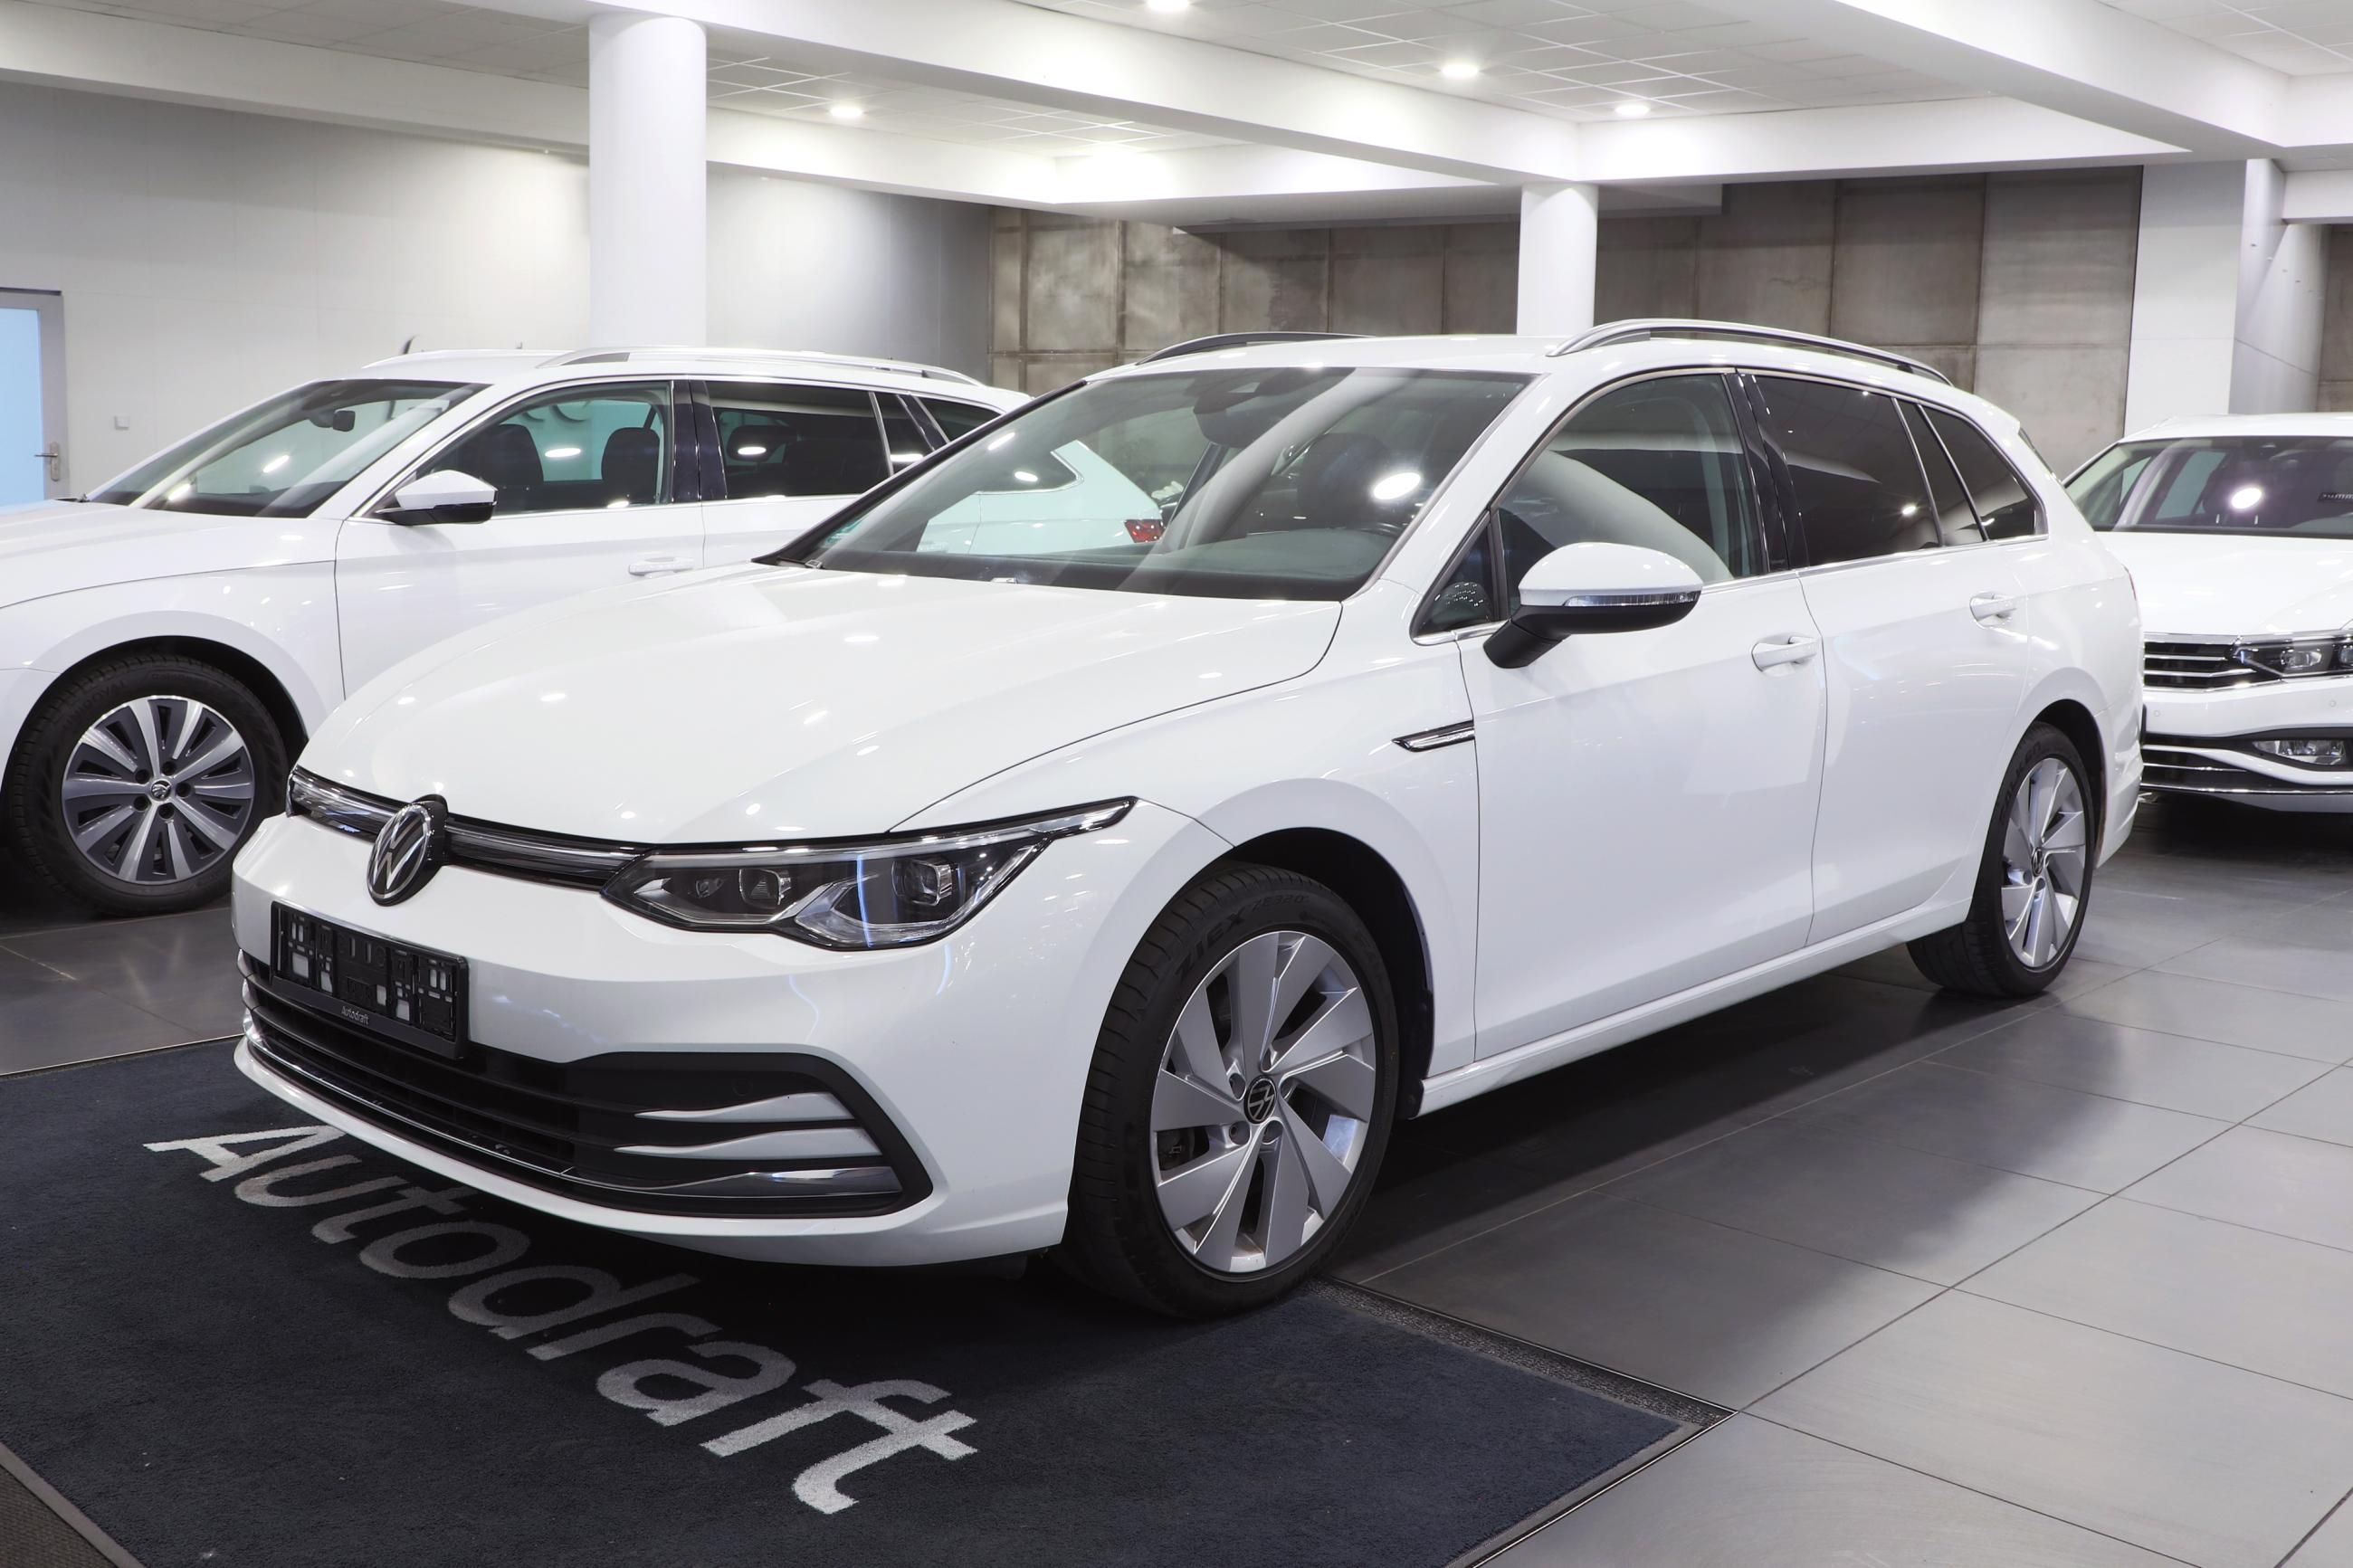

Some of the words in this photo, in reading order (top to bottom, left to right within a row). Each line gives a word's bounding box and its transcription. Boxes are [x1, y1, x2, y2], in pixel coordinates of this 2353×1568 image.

[1175, 907, 1246, 979] ZIEX
[340, 1005, 369, 1026] Autodraft
[144, 1125, 977, 1515] Autodraft
